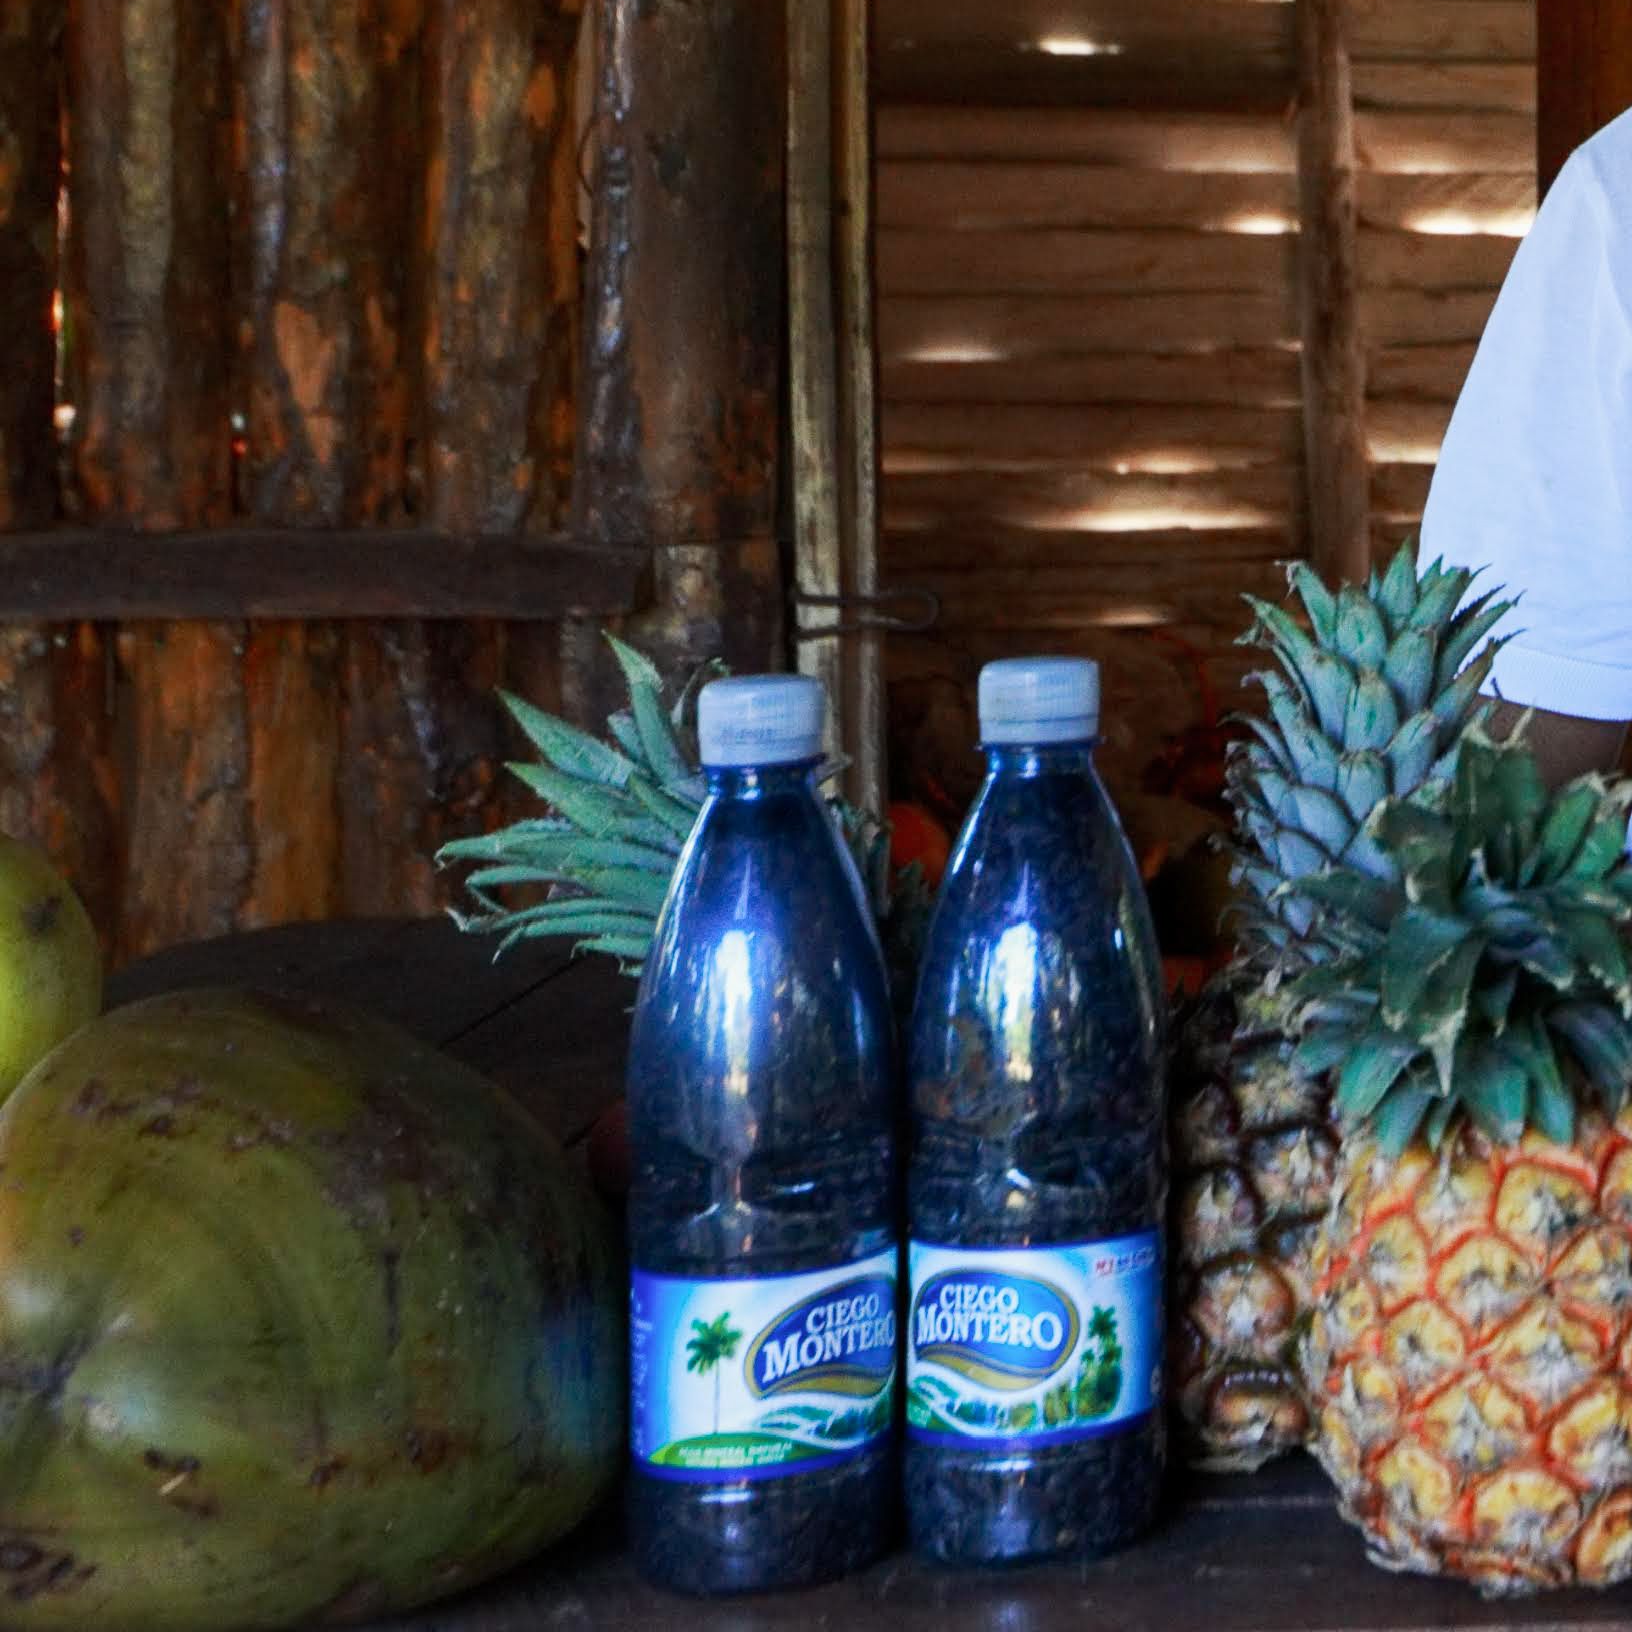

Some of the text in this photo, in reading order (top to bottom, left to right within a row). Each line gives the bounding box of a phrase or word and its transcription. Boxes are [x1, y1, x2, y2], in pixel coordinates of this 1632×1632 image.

[806, 1293, 880, 1335] CIEGO
[940, 1283, 1019, 1314] CIEGO
[762, 1310, 896, 1383] MONTERO
[916, 1303, 1064, 1351] MONTERO
